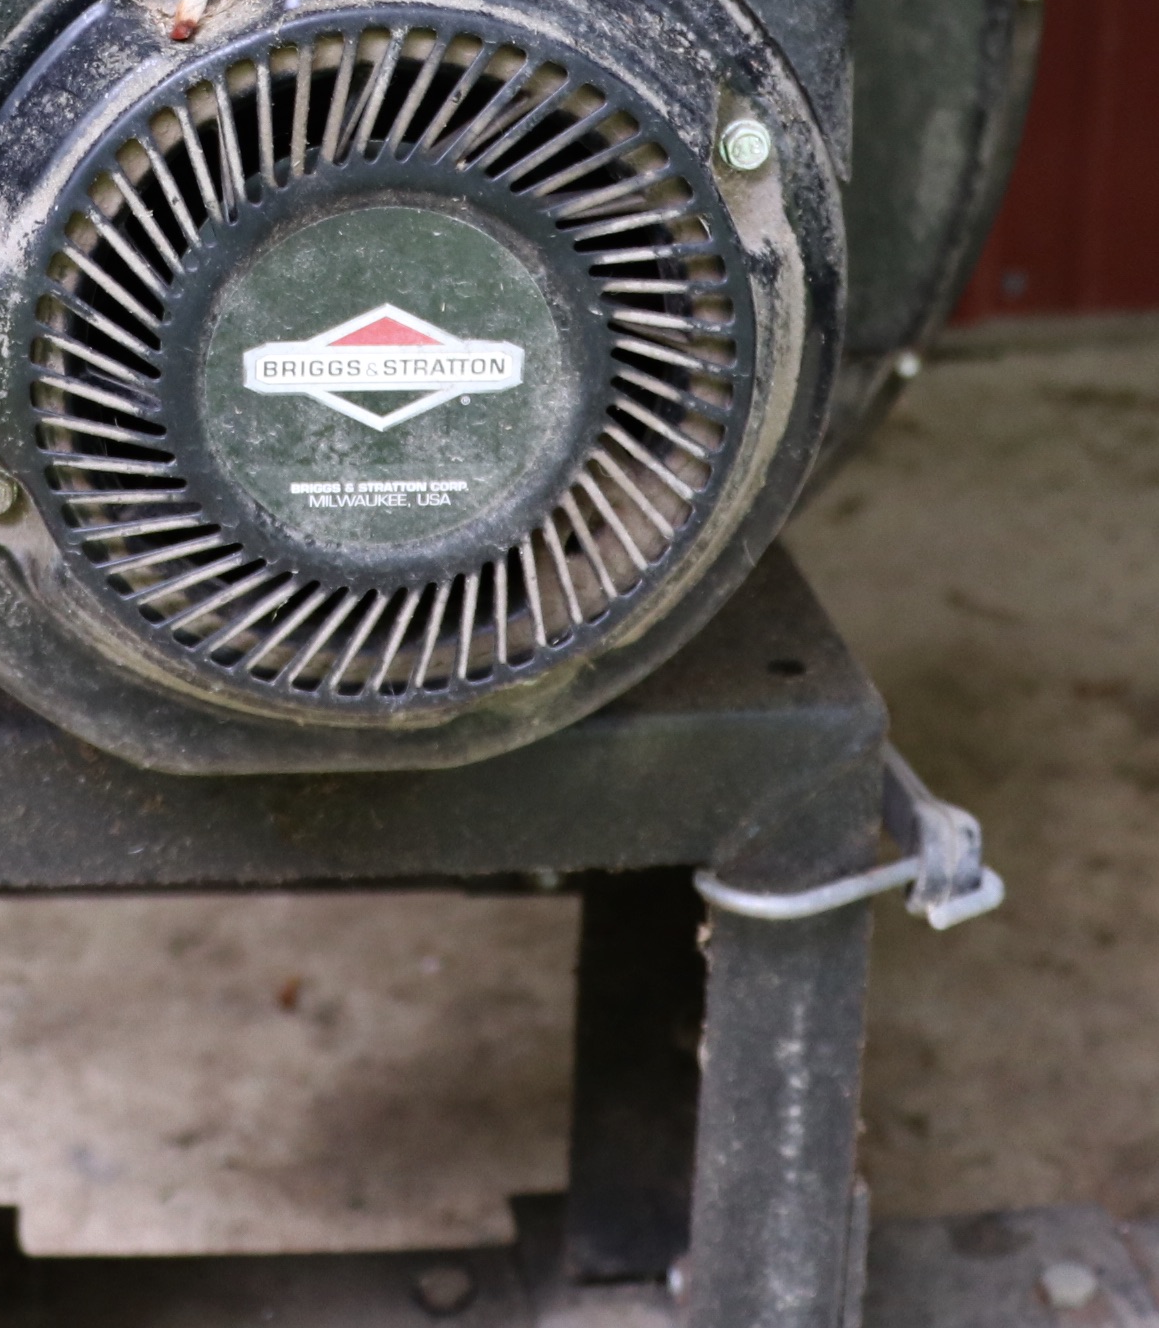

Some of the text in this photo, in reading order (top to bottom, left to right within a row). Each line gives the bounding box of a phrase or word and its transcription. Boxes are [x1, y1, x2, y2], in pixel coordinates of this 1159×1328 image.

[290, 481, 340, 494] BRIGGS
[357, 480, 427, 493] STRATTON
[429, 480, 469, 492] CORP.
[309, 493, 452, 508] MILWAUKEE, USA
